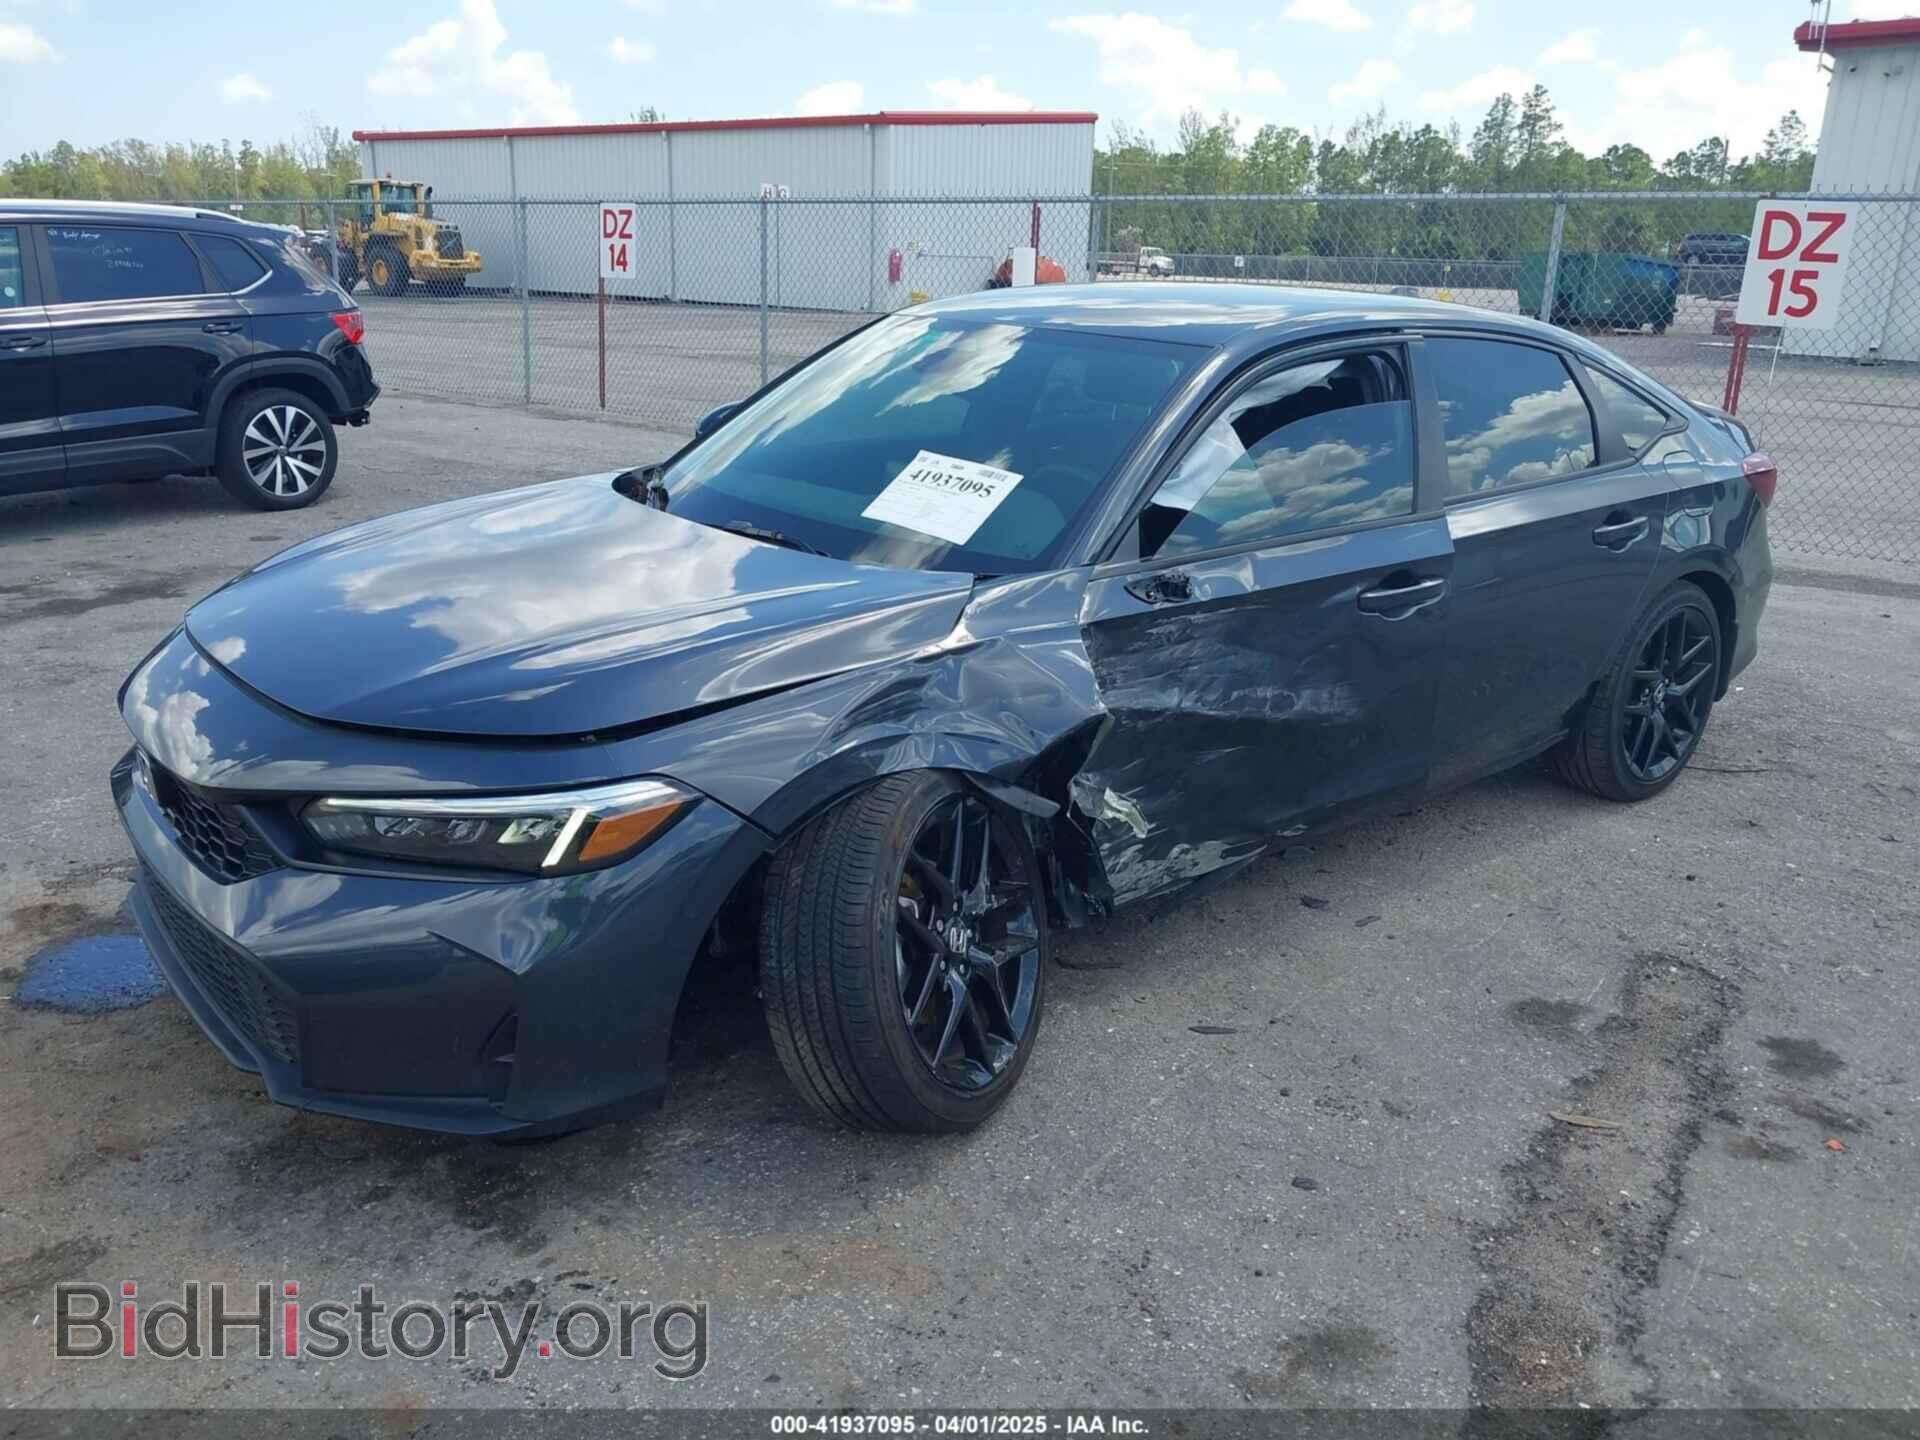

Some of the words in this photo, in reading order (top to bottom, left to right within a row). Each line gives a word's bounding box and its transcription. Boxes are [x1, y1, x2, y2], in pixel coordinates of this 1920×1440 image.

[603, 209, 633, 239] DZ
[1758, 210, 1847, 263] DZ
[608, 243, 628, 272] 14
[1767, 268, 1820, 318] 15
[910, 468, 997, 498] 41937095
